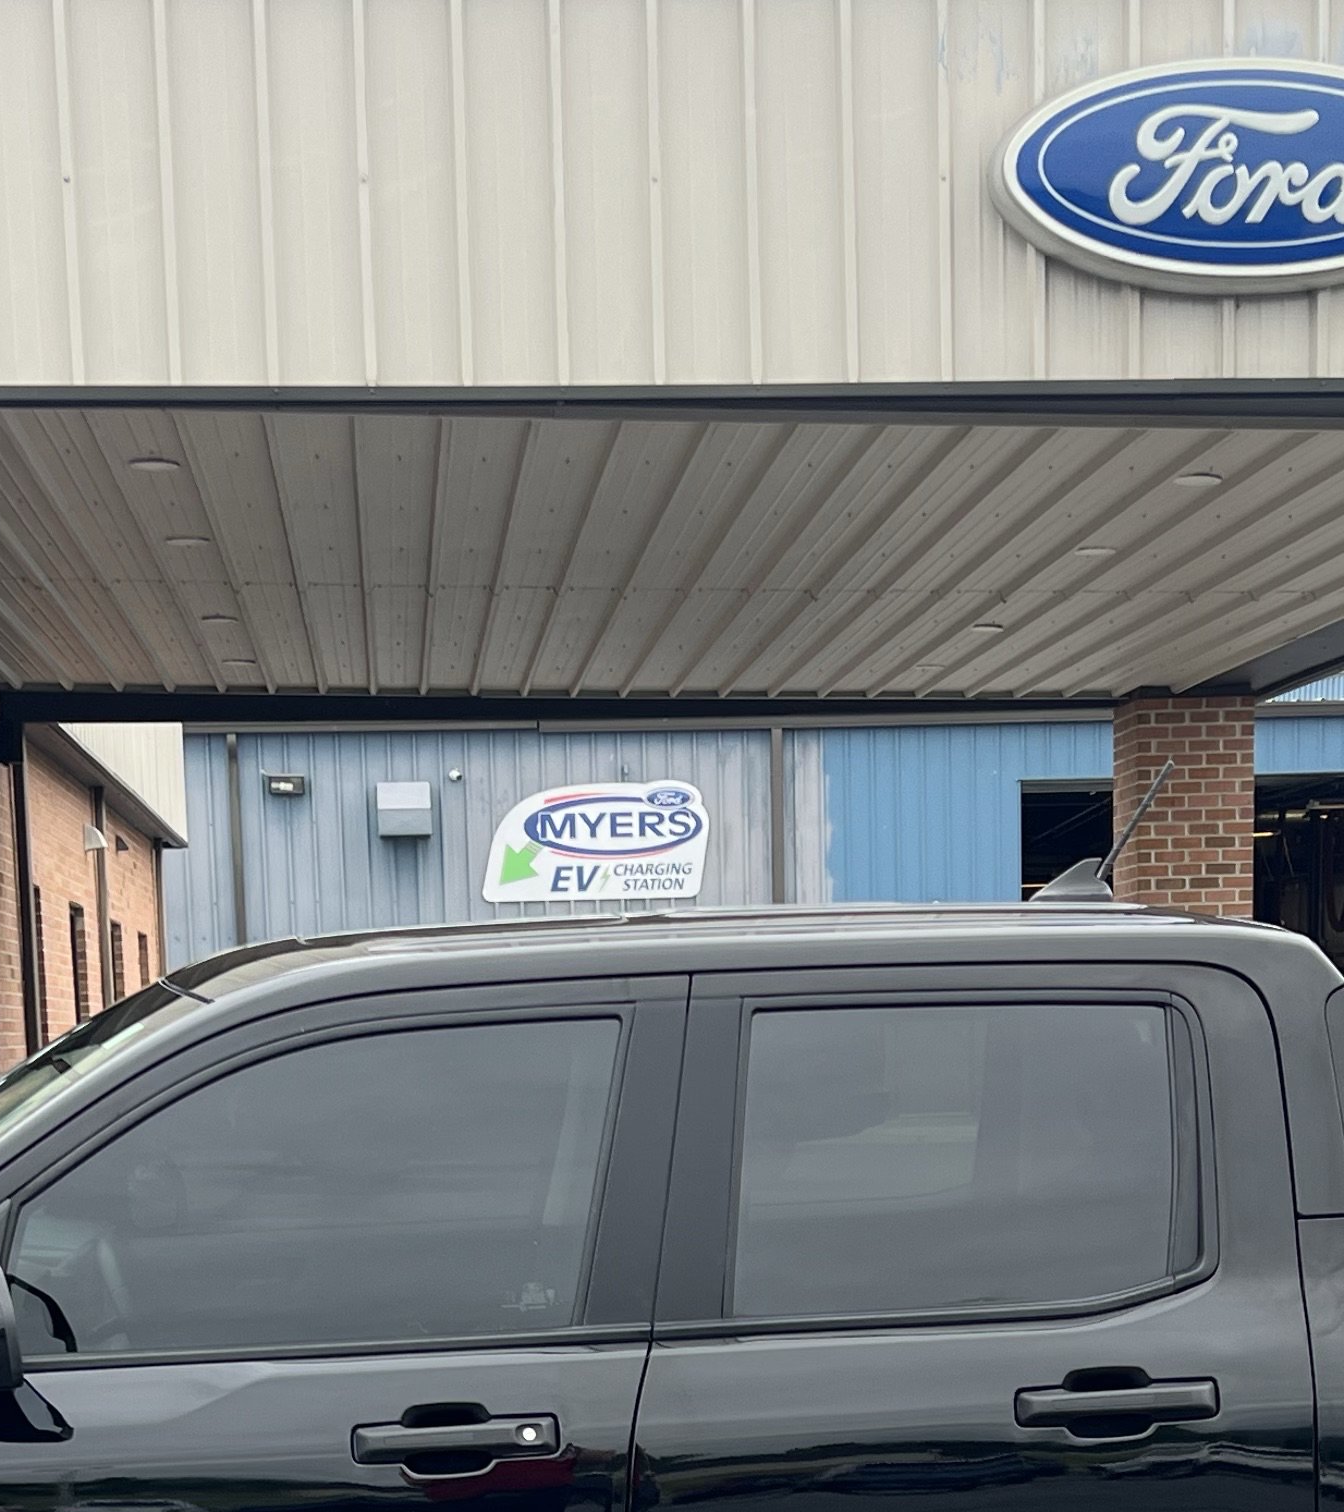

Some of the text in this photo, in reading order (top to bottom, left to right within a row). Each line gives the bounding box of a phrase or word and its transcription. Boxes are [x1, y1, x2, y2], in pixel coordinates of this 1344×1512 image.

[539, 811, 692, 839] MYERS
[550, 865, 600, 892] EV
[613, 863, 693, 877] CHARGING
[622, 877, 685, 891] STATION
